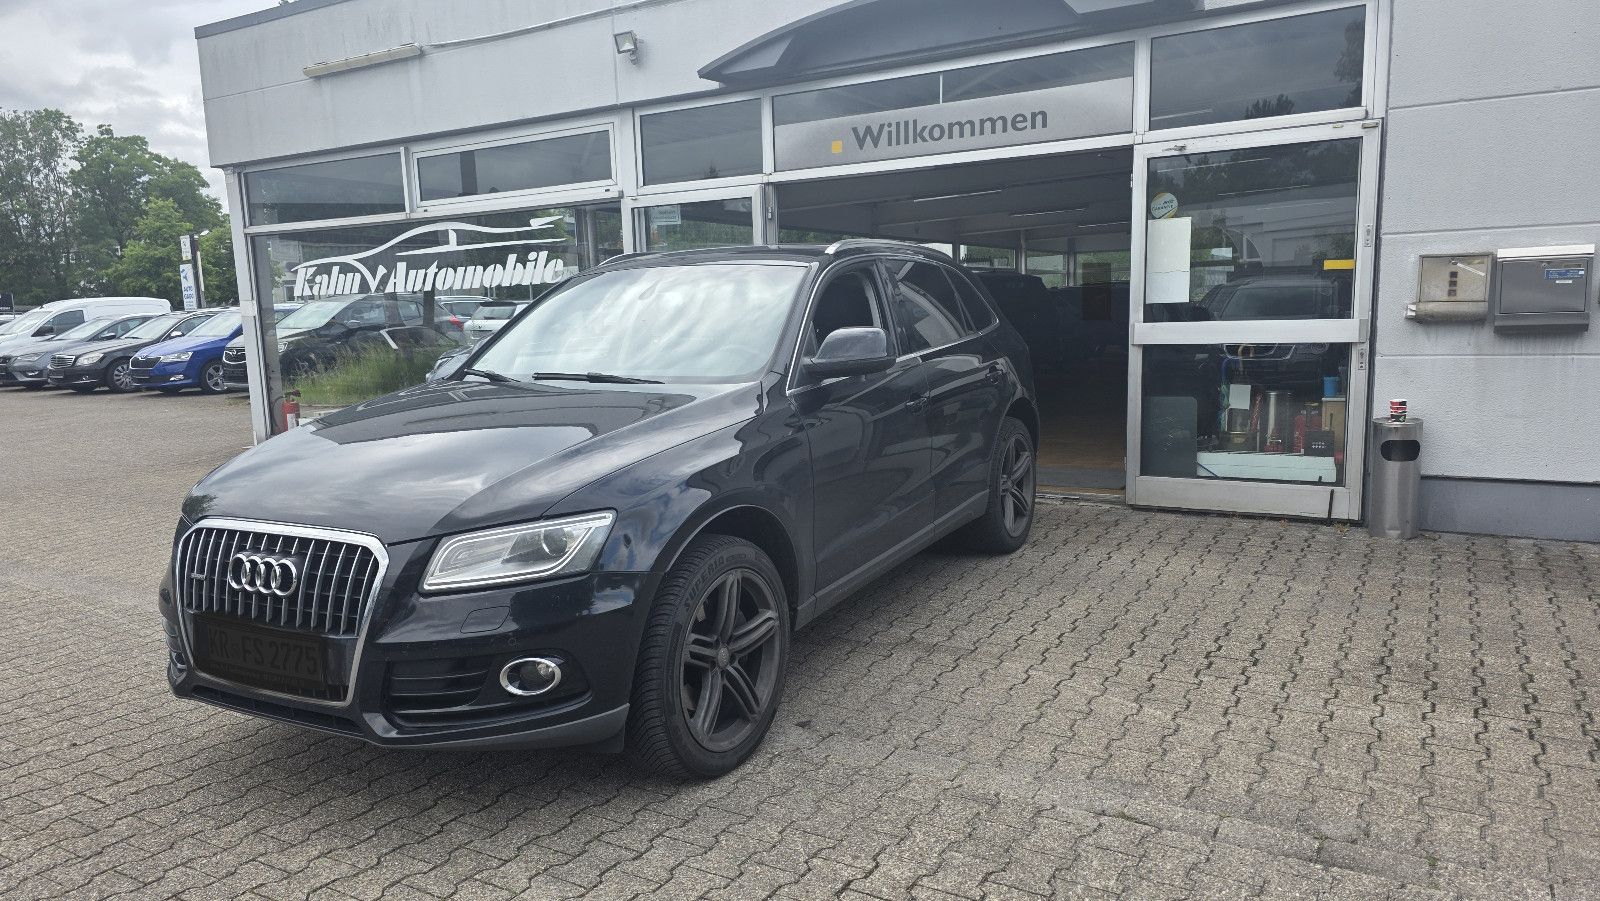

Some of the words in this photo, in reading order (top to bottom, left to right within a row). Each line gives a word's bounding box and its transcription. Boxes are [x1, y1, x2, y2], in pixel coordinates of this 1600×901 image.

[851, 109, 1049, 151] Willkommen
[384, 250, 565, 294] Automobile
[208, 624, 230, 660] KR
[241, 637, 265, 666] FS
[268, 641, 318, 675] 2775
